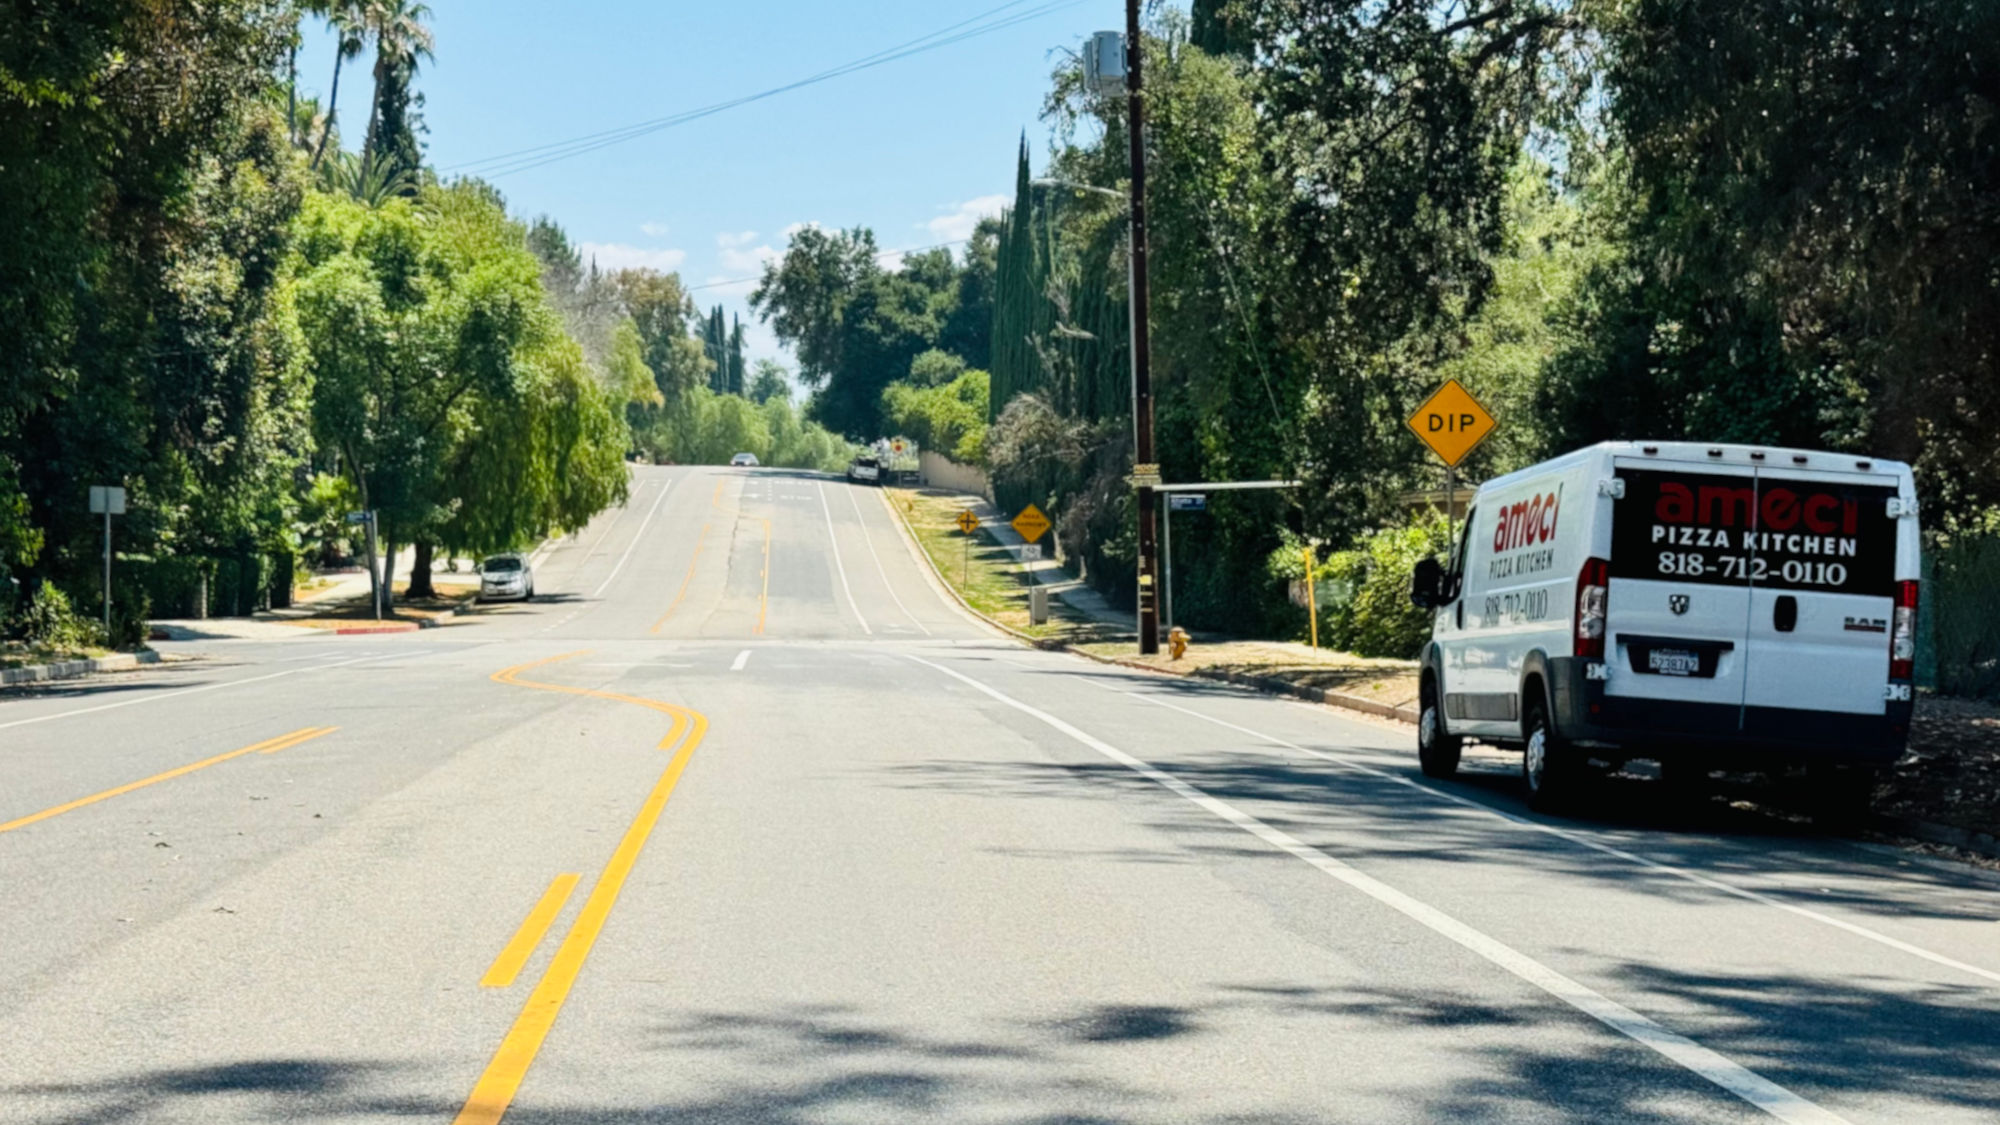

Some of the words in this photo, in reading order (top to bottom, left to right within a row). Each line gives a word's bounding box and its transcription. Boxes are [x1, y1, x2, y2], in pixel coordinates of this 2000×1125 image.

[1428, 413, 1475, 433] DIP
[1493, 482, 1564, 554] ameci
[1655, 481, 1858, 536] ameci
[1652, 525, 1730, 548] PIZZA
[1743, 531, 1857, 557] KITCHEN
[1489, 557, 1513, 581] PIZZA
[1515, 549, 1555, 576] KITCHEN
[1658, 551, 1848, 586] 818-712-0110
